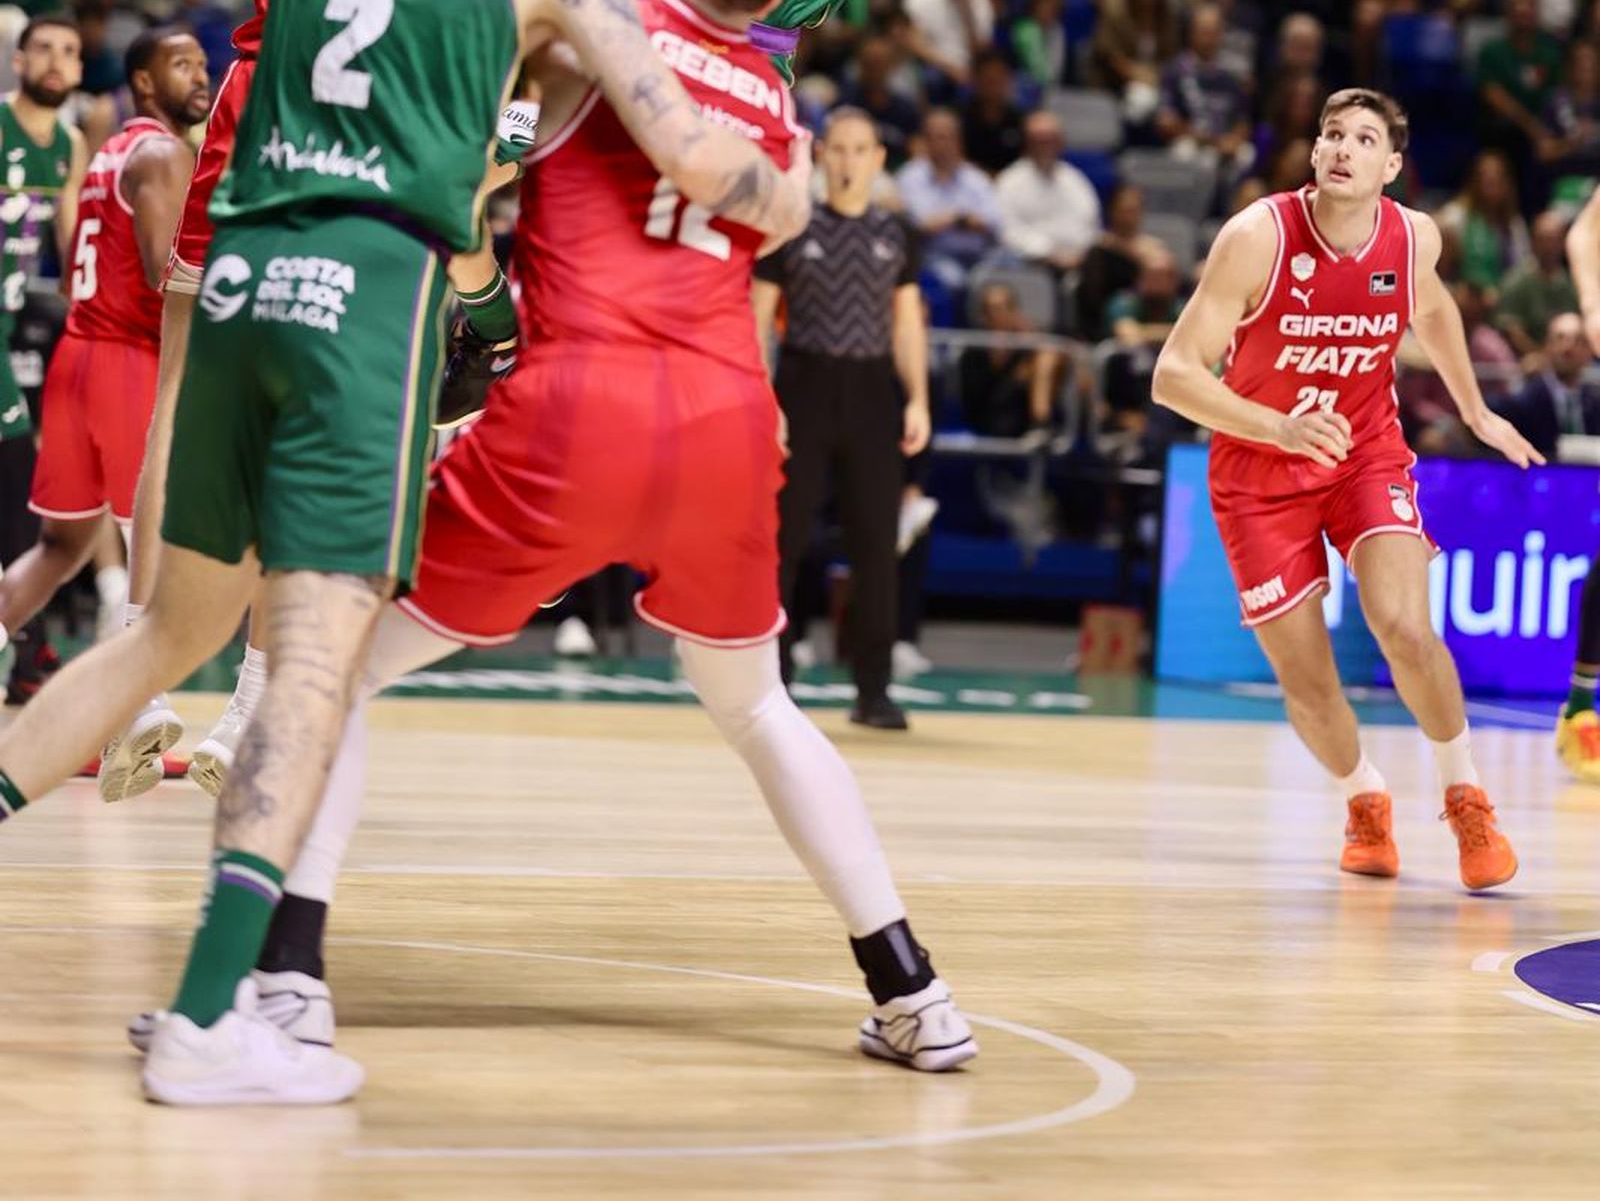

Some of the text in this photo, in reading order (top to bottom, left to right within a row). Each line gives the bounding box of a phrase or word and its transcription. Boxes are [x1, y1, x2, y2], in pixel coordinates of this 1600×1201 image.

[650, 30, 782, 118] GEBEN
[72, 218, 101, 301] 5
[265, 256, 355, 294] COSTA
[1279, 312, 1398, 337] GIRONA
[1274, 344, 1390, 377] FIATC
